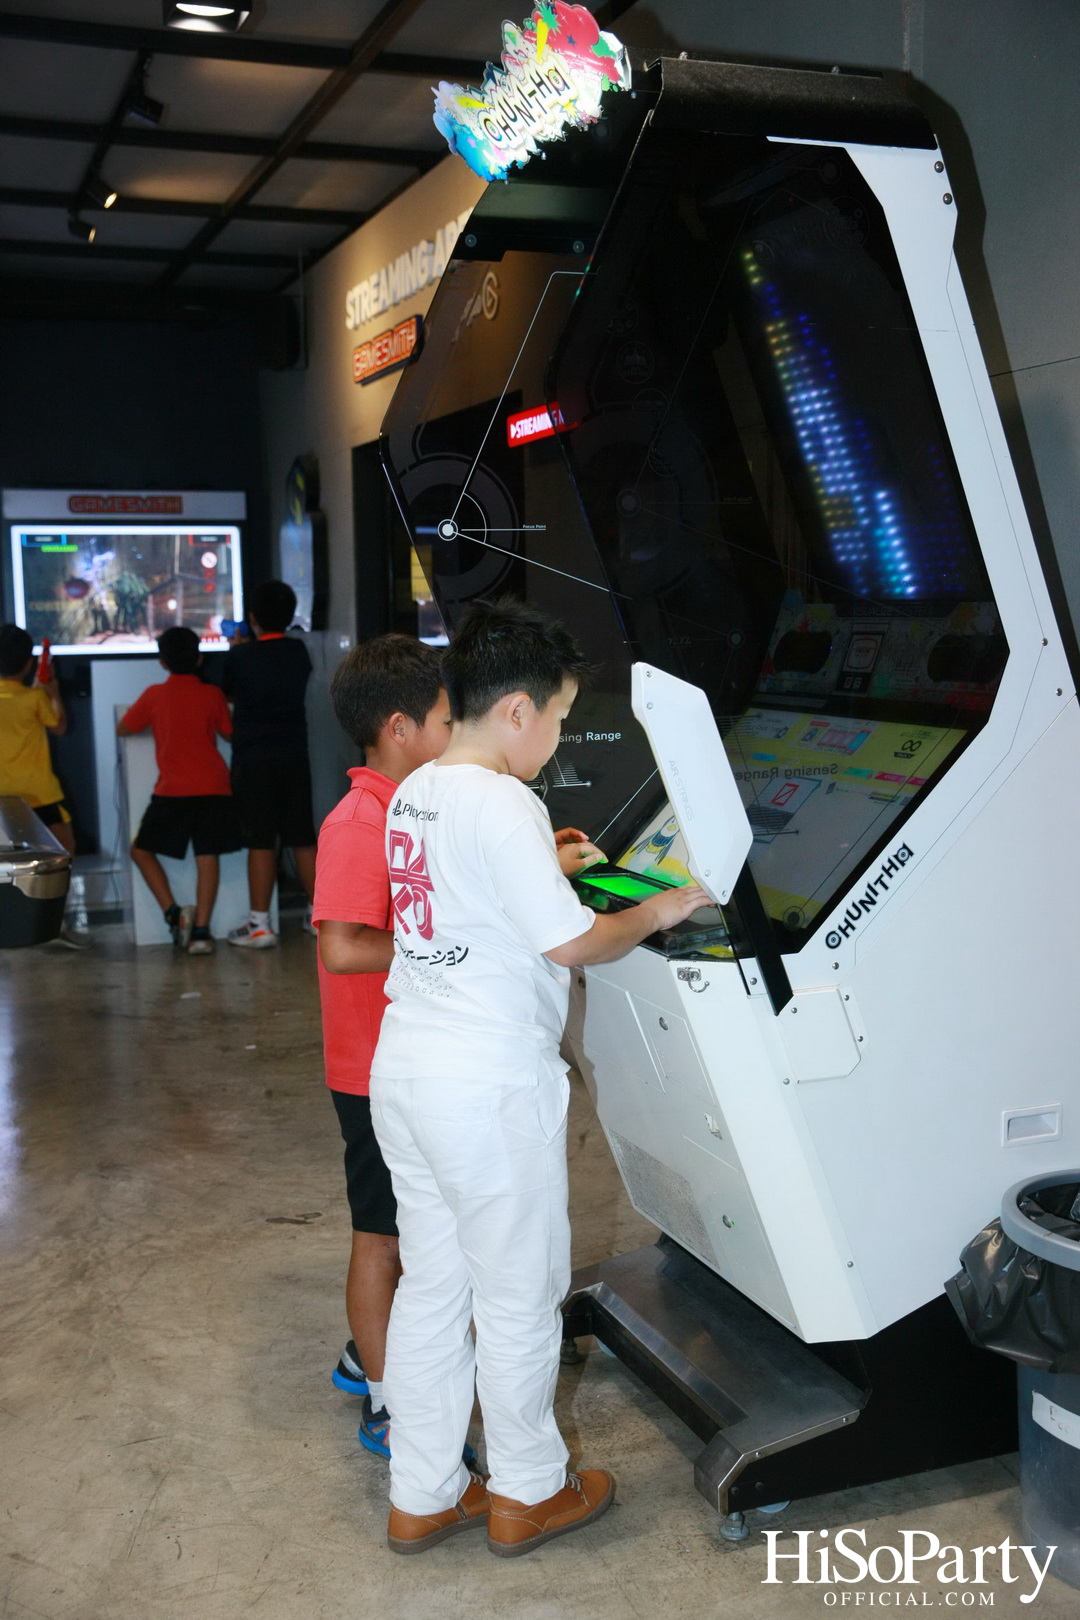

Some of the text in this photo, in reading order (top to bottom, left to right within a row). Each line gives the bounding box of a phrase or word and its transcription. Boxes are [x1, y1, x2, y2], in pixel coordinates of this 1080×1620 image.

[345, 239, 435, 331] STREAMING
[559, 731, 622, 744] sing Range
